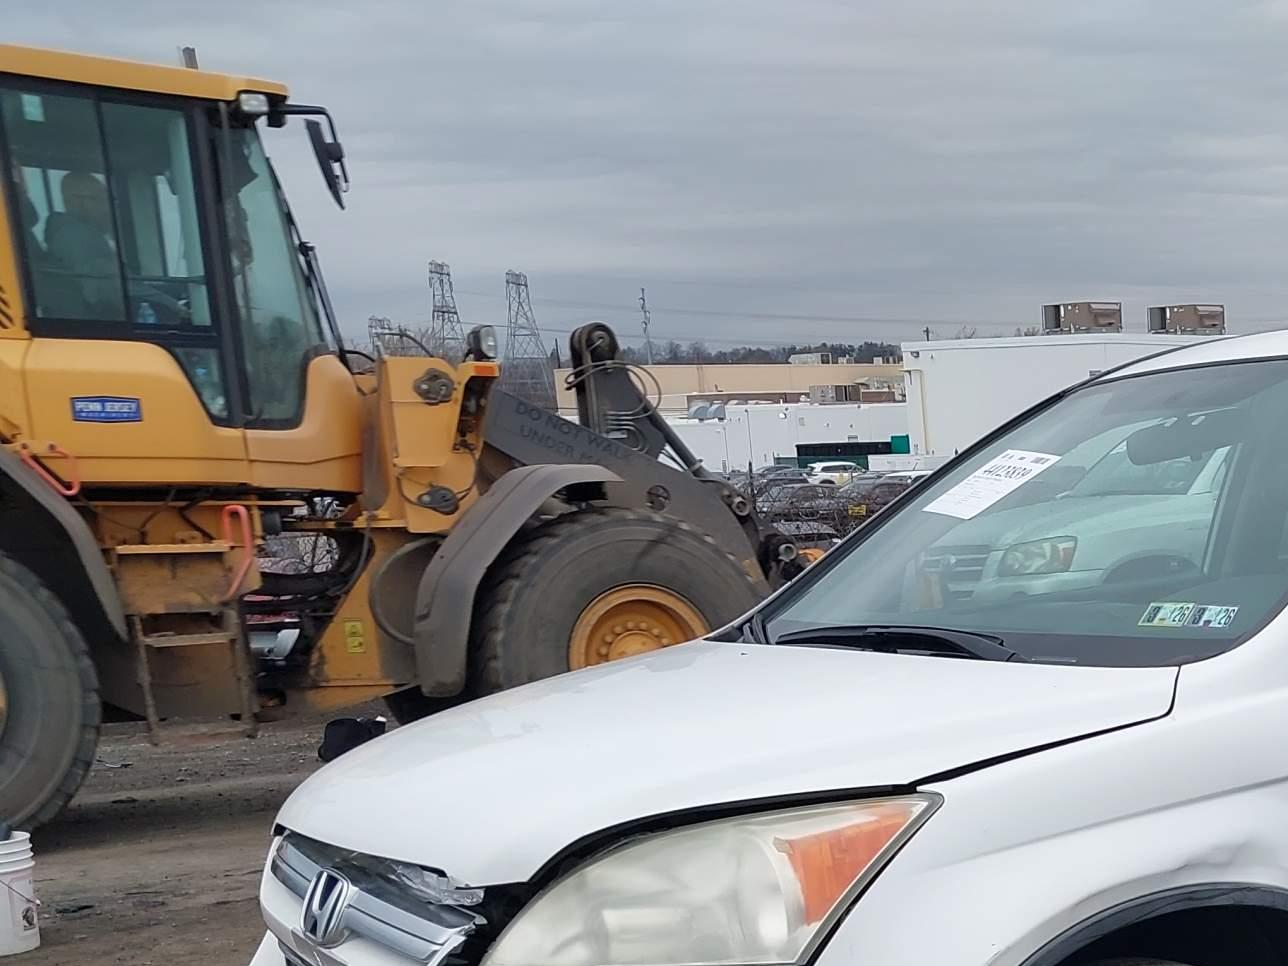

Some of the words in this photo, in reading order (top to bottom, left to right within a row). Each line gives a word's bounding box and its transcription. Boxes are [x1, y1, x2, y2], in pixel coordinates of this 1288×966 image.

[515, 401, 542, 422] DO
[545, 415, 585, 440] NOT
[587, 430, 630, 461] WAL
[519, 424, 577, 459] UNDER
